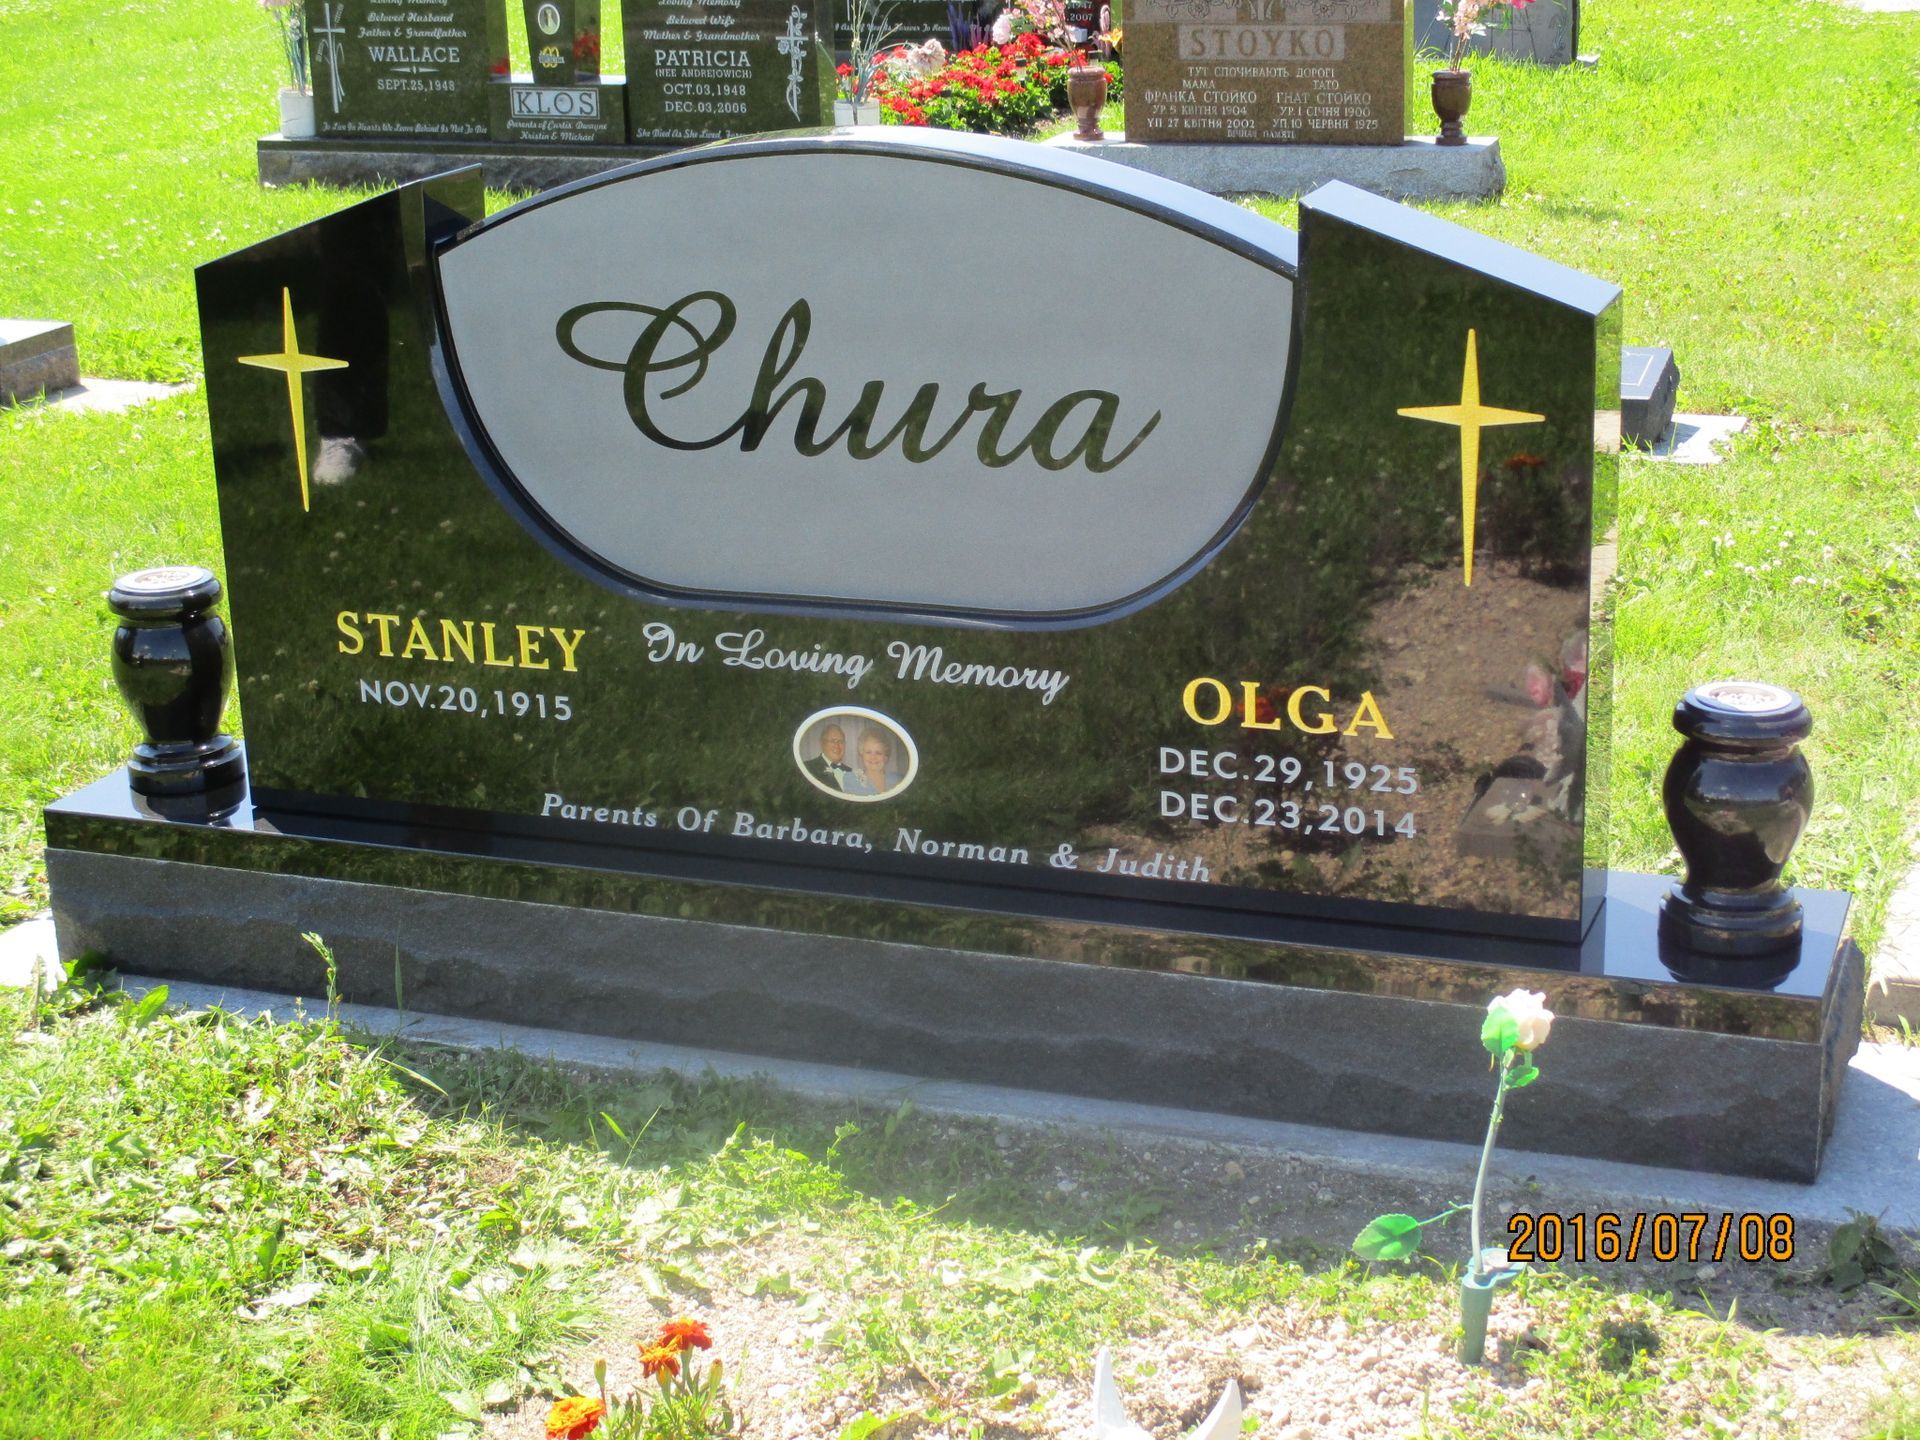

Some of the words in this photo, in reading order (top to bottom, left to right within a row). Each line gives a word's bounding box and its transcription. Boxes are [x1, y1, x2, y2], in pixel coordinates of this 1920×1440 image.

[368, 11, 405, 22] Beloved
[407, 12, 453, 22] Husband
[666, 15, 707, 25] Beloved
[710, 15, 735, 27] Wife
[357, 27, 391, 38] Father
[394, 27, 402, 37] &
[405, 27, 467, 39] Grandfather
[643, 30, 680, 40] Mother
[684, 30, 692, 40] &
[695, 30, 760, 41] Grandmother
[1190, 29, 1335, 58] STOYKO
[368, 46, 460, 63] WALLACE
[654, 50, 751, 67] PATRICIA
[1188, 66, 1208, 77] ТУТ
[1214, 66, 1289, 78] СПОЧИВАЮТЬ
[377, 79, 456, 92] SEPT.25,1948
[663, 83, 746, 96] OCT.03,1948
[1182, 79, 1216, 89] МАМА
[1313, 80, 1339, 90] ТАТО
[515, 91, 595, 115] KLOS
[1145, 89, 1196, 103] ФРАНКА
[1203, 89, 1257, 104] СТОЙКО
[1276, 91, 1310, 104] ГНАТ
[1316, 90, 1371, 105] СТОЙКО
[665, 101, 747, 114] DEC.03,2006
[1168, 118, 1179, 128] 27
[1227, 119, 1255, 129] 2002
[1356, 119, 1378, 129] 1975
[520, 131, 549, 140] Kristin
[550, 132, 557, 140] &
[560, 132, 594, 141] Michael
[555, 290, 1161, 473] Chura
[336, 610, 586, 672] STANLEY
[642, 622, 704, 662] In
[715, 629, 873, 689] Loving
[887, 641, 1070, 705] Memory
[359, 678, 572, 721] NOV.20,1915
[1182, 677, 1394, 739] OLGA
[1160, 747, 1418, 795] DEC.29,1925
[1160, 790, 1416, 839] DEC.23,2014
[541, 793, 657, 828] Parents
[677, 806, 718, 833] Of
[731, 811, 873, 853] Barbara,
[893, 828, 1029, 865] Norman
[1050, 843, 1079, 869] &
[1096, 847, 1209, 882] Judith
